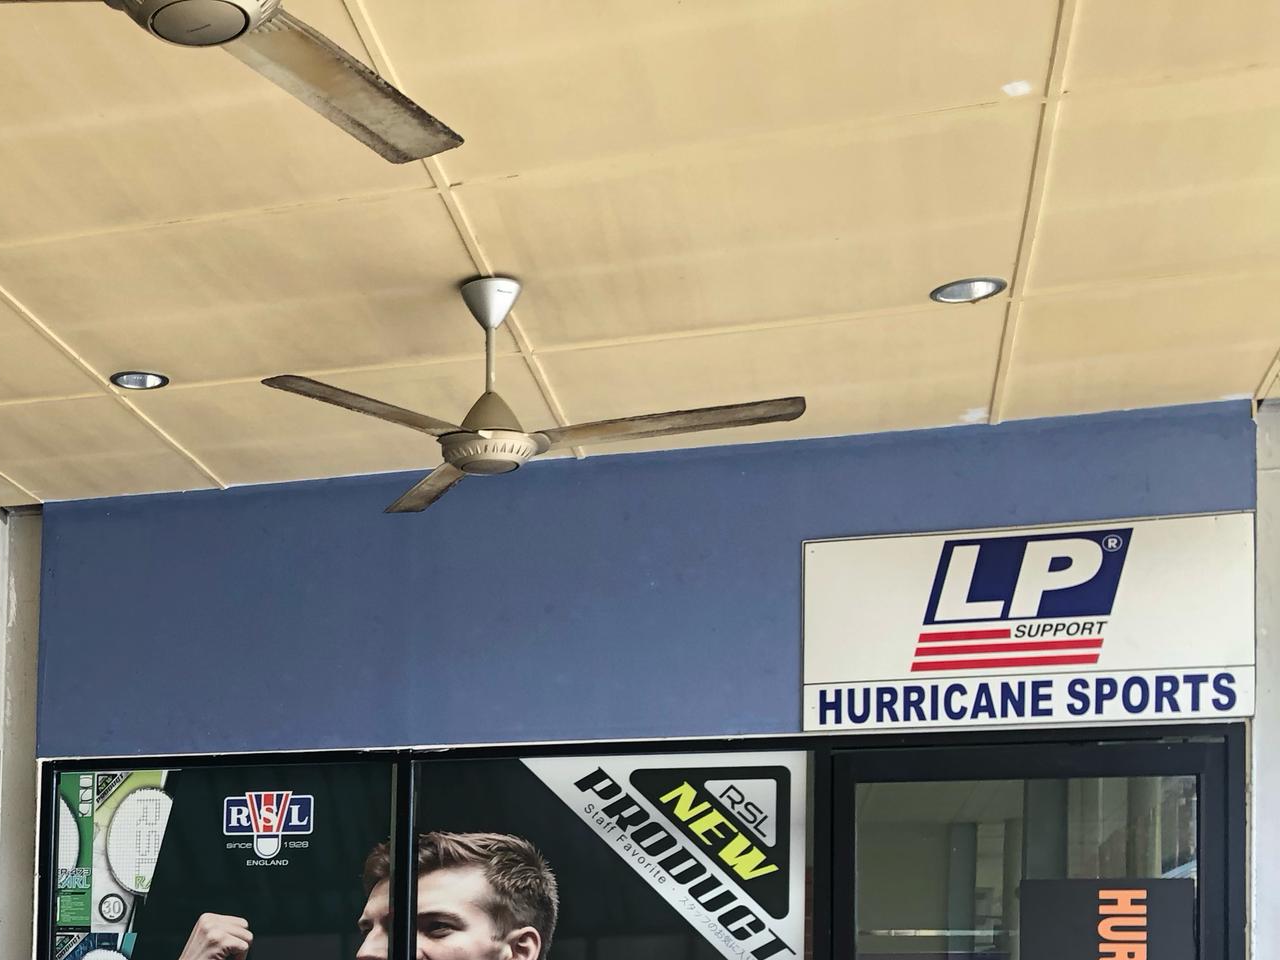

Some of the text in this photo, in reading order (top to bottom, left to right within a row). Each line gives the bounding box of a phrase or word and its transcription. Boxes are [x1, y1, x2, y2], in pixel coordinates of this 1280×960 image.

[1014, 620, 1107, 639] SUPPORT
[819, 672, 1237, 725] HURRICANE SPORTS
[228, 804, 309, 827] RSL
[658, 781, 779, 881] NEW
[719, 784, 768, 838] RSL
[226, 841, 252, 849] since
[583, 802, 668, 885] Staff Favorite
